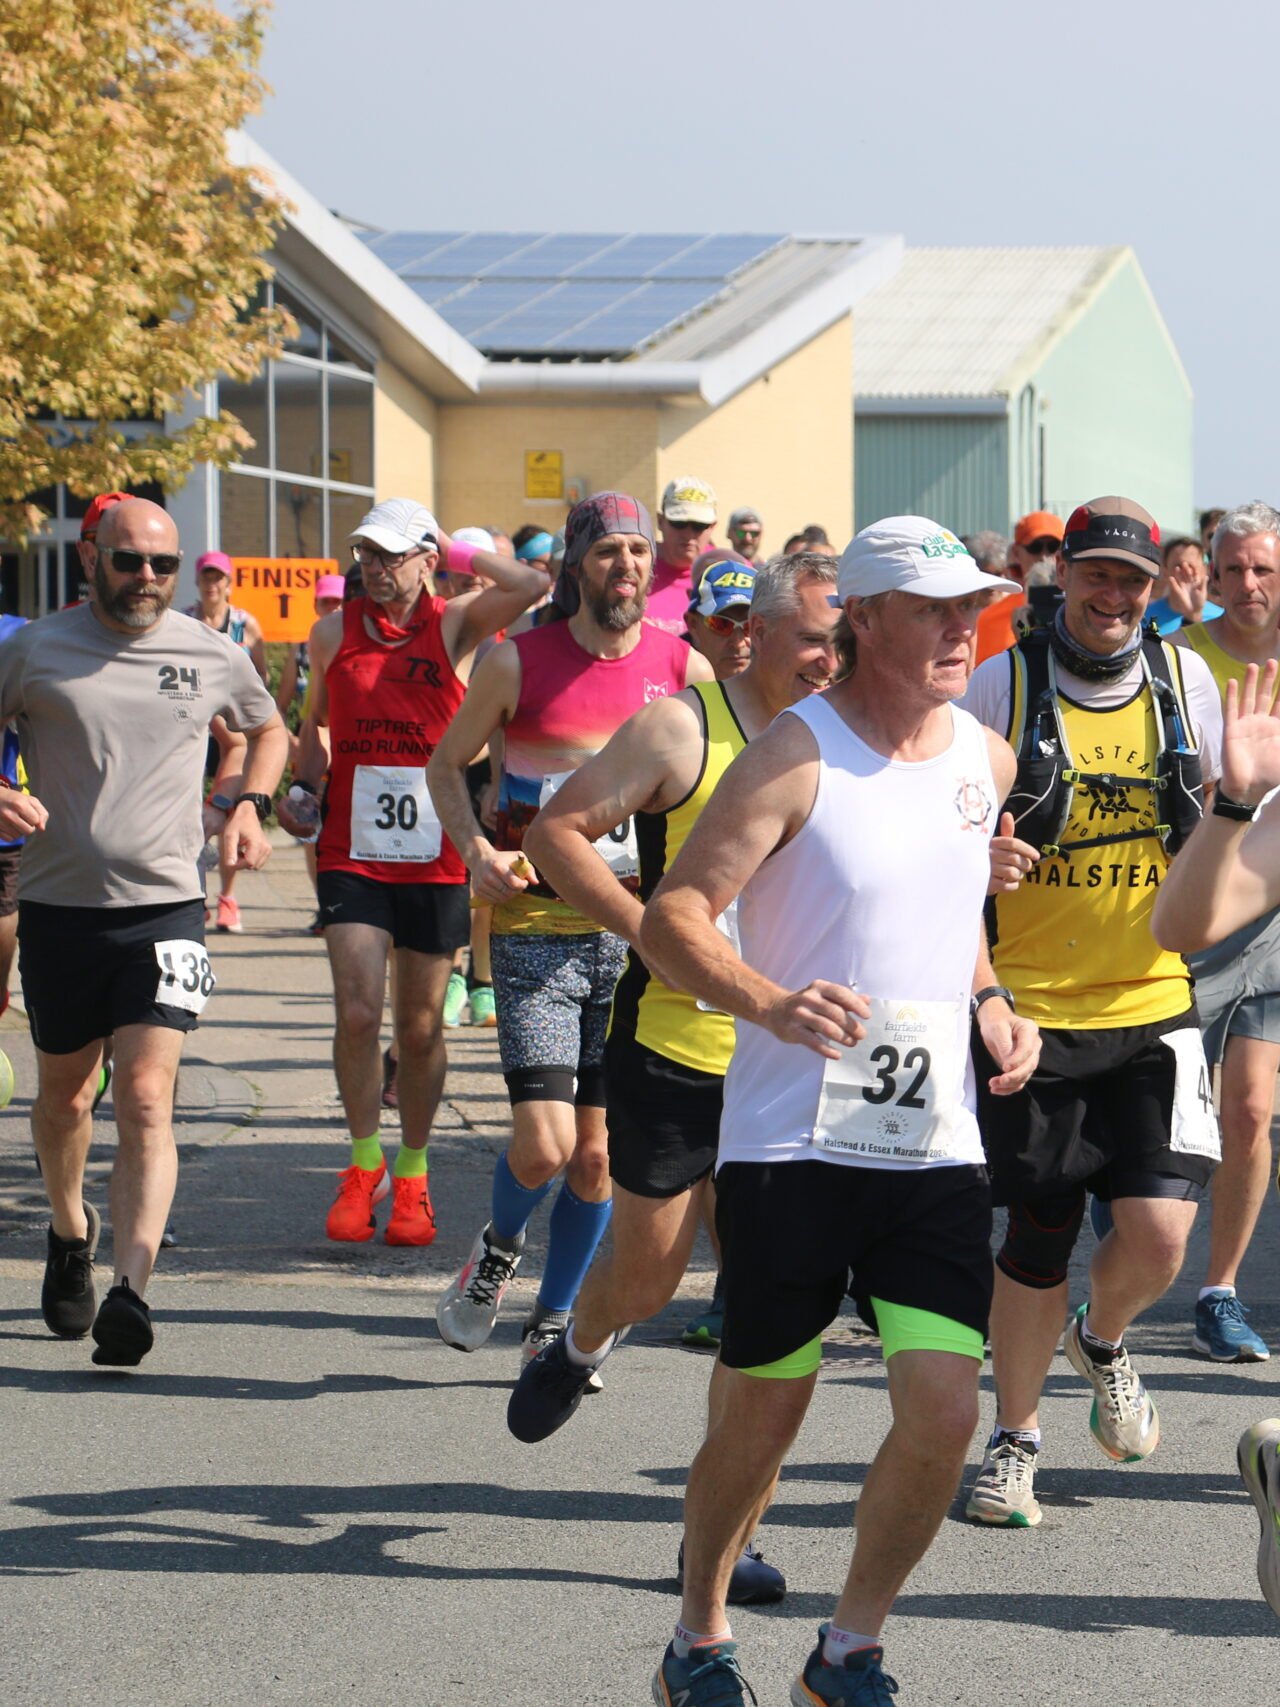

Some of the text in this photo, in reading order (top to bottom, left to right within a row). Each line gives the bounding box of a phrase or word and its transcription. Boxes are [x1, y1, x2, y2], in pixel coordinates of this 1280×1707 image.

[713, 571, 754, 588] 46
[158, 664, 198, 691] 24
[355, 718, 428, 737] TIPTREE
[375, 739, 437, 757] RUNNE
[375, 793, 418, 831] 30
[1026, 863, 1170, 888] HALSTEA
[884, 1021, 928, 1032] fairfields
[893, 1032, 918, 1042] farm
[861, 1044, 932, 1110] 32
[824, 1138, 858, 1151] Halstead
[860, 1142, 866, 1152] &
[868, 1143, 891, 1155] Essex
[893, 1146, 928, 1158] Marathon
